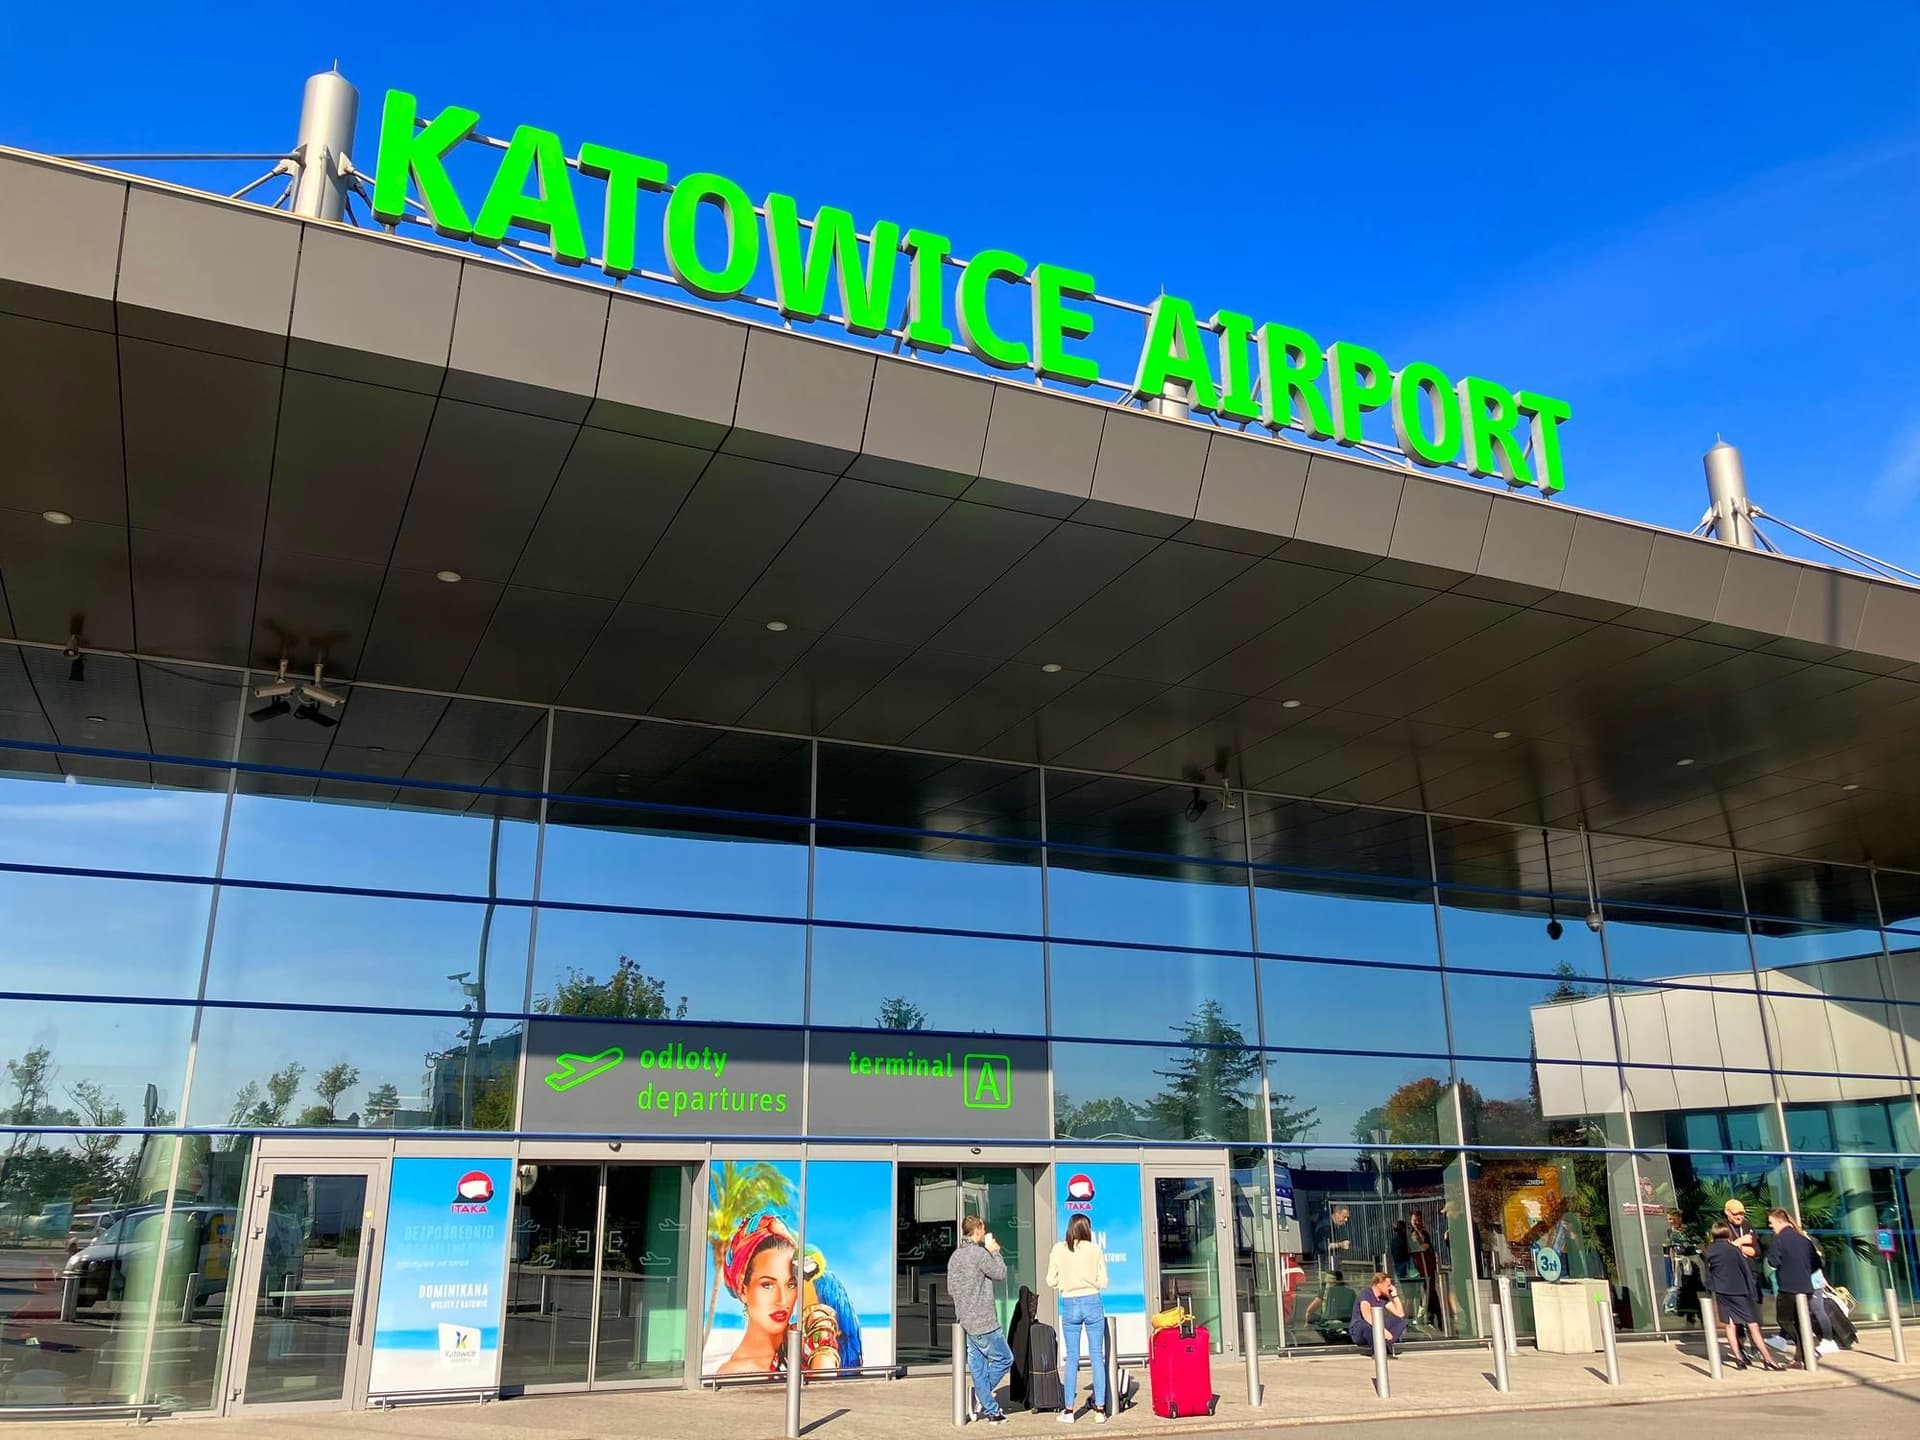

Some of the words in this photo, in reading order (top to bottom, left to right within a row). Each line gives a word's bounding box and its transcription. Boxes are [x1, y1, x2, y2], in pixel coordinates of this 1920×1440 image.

[372, 89, 1099, 384] KATOWICE
[1133, 295, 1571, 494] AIRPORT
[639, 1043, 728, 1078] odloty
[849, 1051, 954, 1079] terminal
[974, 1061, 1001, 1102] A
[637, 1082, 788, 1117] departures
[451, 1204, 488, 1213] ITAKA
[1066, 1202, 1091, 1210] ITAKA
[419, 1283, 488, 1298] DOMINIKANA
